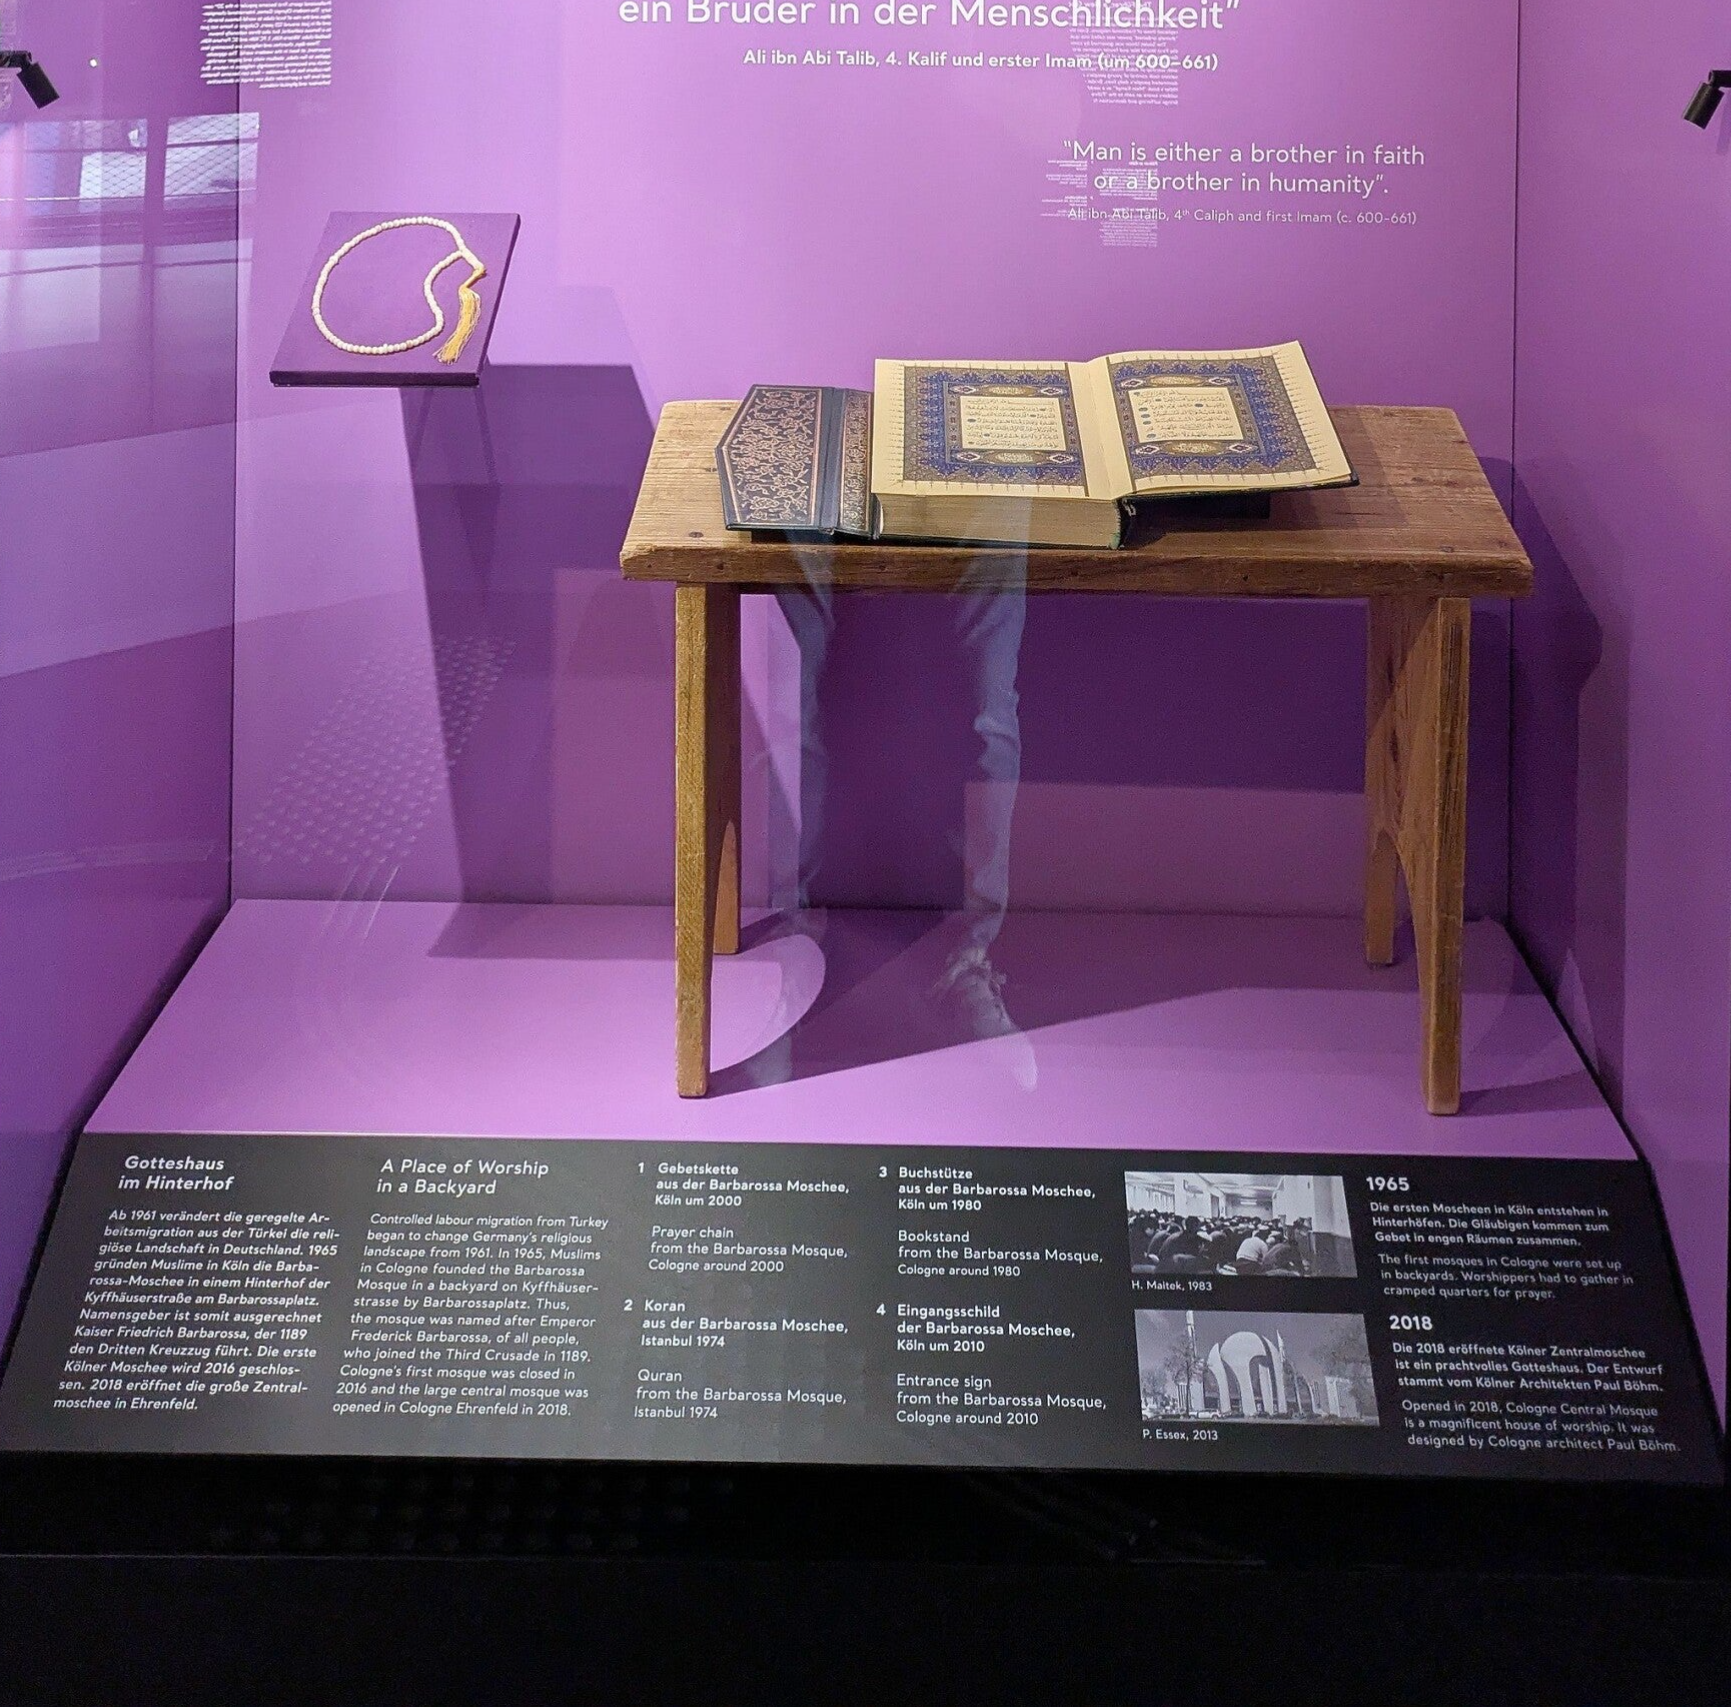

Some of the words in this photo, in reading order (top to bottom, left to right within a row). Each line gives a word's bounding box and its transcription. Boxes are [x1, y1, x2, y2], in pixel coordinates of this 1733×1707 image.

[743, 49, 766, 65] Ali
[771, 50, 797, 65] ibn
[802, 50, 831, 65] Abi
[836, 50, 880, 68] Talib,
[885, 51, 902, 66] 4.
[908, 51, 947, 67] Kalif
[952, 52, 983, 68] und
[988, 54, 1040, 69] erster
[1046, 53, 1092, 69] Imam
[1097, 52, 1129, 71] (um
[1131, 142, 1146, 161] is
[1155, 142, 1222, 162] either
[1230, 149, 1242, 162] a
[1251, 143, 1337, 163] brother
[1346, 145, 1364, 163] in
[1373, 144, 1425, 165] faith
[1094, 175, 1118, 189] or
[1126, 177, 1138, 190] a
[1147, 170, 1233, 191] brother
[1242, 173, 1260, 192] in
[1068, 208, 1084, 220] Ali
[1088, 208, 1106, 220] ibn
[1113, 209, 1133, 220] Abi
[1138, 209, 1169, 222] Talib,
[1194, 210, 1233, 224] Caliph
[1238, 211, 1261, 222] and
[1266, 211, 1293, 222] first
[1297, 211, 1332, 223] Imam
[1337, 211, 1352, 224] (c.
[125, 1156, 224, 1170] Gotteshaus
[380, 1159, 393, 1172] A
[401, 1159, 446, 1173] Place
[453, 1160, 472, 1174] of
[478, 1160, 548, 1178] Worship
[638, 1162, 644, 1173] 1
[658, 1162, 738, 1174] Gebetskette
[879, 1166, 887, 1178] 3
[900, 1166, 972, 1179] Buchstütze
[118, 1175, 140, 1189] im
[146, 1176, 234, 1190] Hinterhof
[377, 1178, 392, 1192] in
[398, 1183, 408, 1193] a
[414, 1179, 496, 1198] Backyard
[656, 1181, 678, 1190] aus
[682, 1178, 705, 1190] der
[710, 1179, 782, 1191] Barbarossa
[787, 1180, 849, 1194] Moschee,
[899, 1185, 920, 1194] aus
[925, 1182, 948, 1194] der
[953, 1183, 1027, 1196] Barbarossa
[1032, 1184, 1095, 1198] Moschee,
[1366, 1176, 1410, 1191] 1965
[655, 1194, 681, 1205] Köln
[708, 1195, 742, 1206] 2000
[899, 1198, 925, 1209] Köln
[929, 1202, 948, 1210] um
[952, 1200, 981, 1210] 1980
[109, 1210, 126, 1220] Ab
[132, 1210, 156, 1220] 1961
[160, 1211, 220, 1221] verändert
[224, 1211, 242, 1222] die
[246, 1212, 305, 1225] geregelte
[308, 1212, 330, 1222] Ar-
[652, 1226, 696, 1240] Prayer
[700, 1226, 733, 1238] chain
[899, 1230, 969, 1242] Bookstand
[651, 1241, 682, 1253] from
[688, 1242, 708, 1254] the
[714, 1242, 786, 1255] Barbarossa
[792, 1244, 847, 1259] Mosque,
[898, 1246, 931, 1258] from
[936, 1246, 958, 1258] the
[964, 1247, 1040, 1260] Barbarossa
[1045, 1249, 1102, 1264] Mosque,
[648, 1258, 699, 1273] Cologne
[704, 1260, 746, 1271] around
[750, 1260, 784, 1272] 2000
[898, 1264, 945, 1277] Cologne
[949, 1266, 989, 1276] around
[993, 1266, 1020, 1276] 1980
[1132, 1280, 1143, 1289] H.
[1188, 1280, 1212, 1291] 1983
[624, 1299, 633, 1311] 2
[645, 1299, 685, 1312] Koran
[876, 1303, 886, 1315] 4
[898, 1304, 1000, 1320] Eingangsschild
[642, 1320, 666, 1328] aus
[670, 1316, 695, 1329] der
[700, 1317, 777, 1330] Barbarossa
[782, 1318, 848, 1334] Moschee,
[897, 1320, 921, 1333] der
[926, 1322, 1004, 1335] Barbarossa
[1009, 1323, 1075, 1338] Moschee,
[1389, 1315, 1433, 1330] 2018
[641, 1334, 692, 1346] Istanbul
[697, 1336, 725, 1347] 1974
[897, 1339, 925, 1351] Köln
[930, 1343, 949, 1351] um
[954, 1340, 984, 1352] 2010
[638, 1369, 682, 1382] Quran
[897, 1374, 959, 1387] Entrance
[964, 1375, 991, 1390] sign
[636, 1386, 670, 1399] from
[676, 1387, 698, 1400] the
[704, 1388, 782, 1402] Barbarossa
[788, 1389, 846, 1406] Mosque,
[897, 1391, 930, 1404] from
[936, 1392, 958, 1405] the
[964, 1392, 1042, 1406] Barbarossa
[1047, 1394, 1106, 1411] Mosque,
[634, 1406, 685, 1418] Istanbul
[690, 1406, 718, 1418] 1974
[896, 1410, 951, 1426] Cologne
[956, 1412, 1002, 1424] around
[1007, 1412, 1038, 1425] 2010
[1143, 1429, 1152, 1439] P.
[1193, 1430, 1218, 1440] 2013
